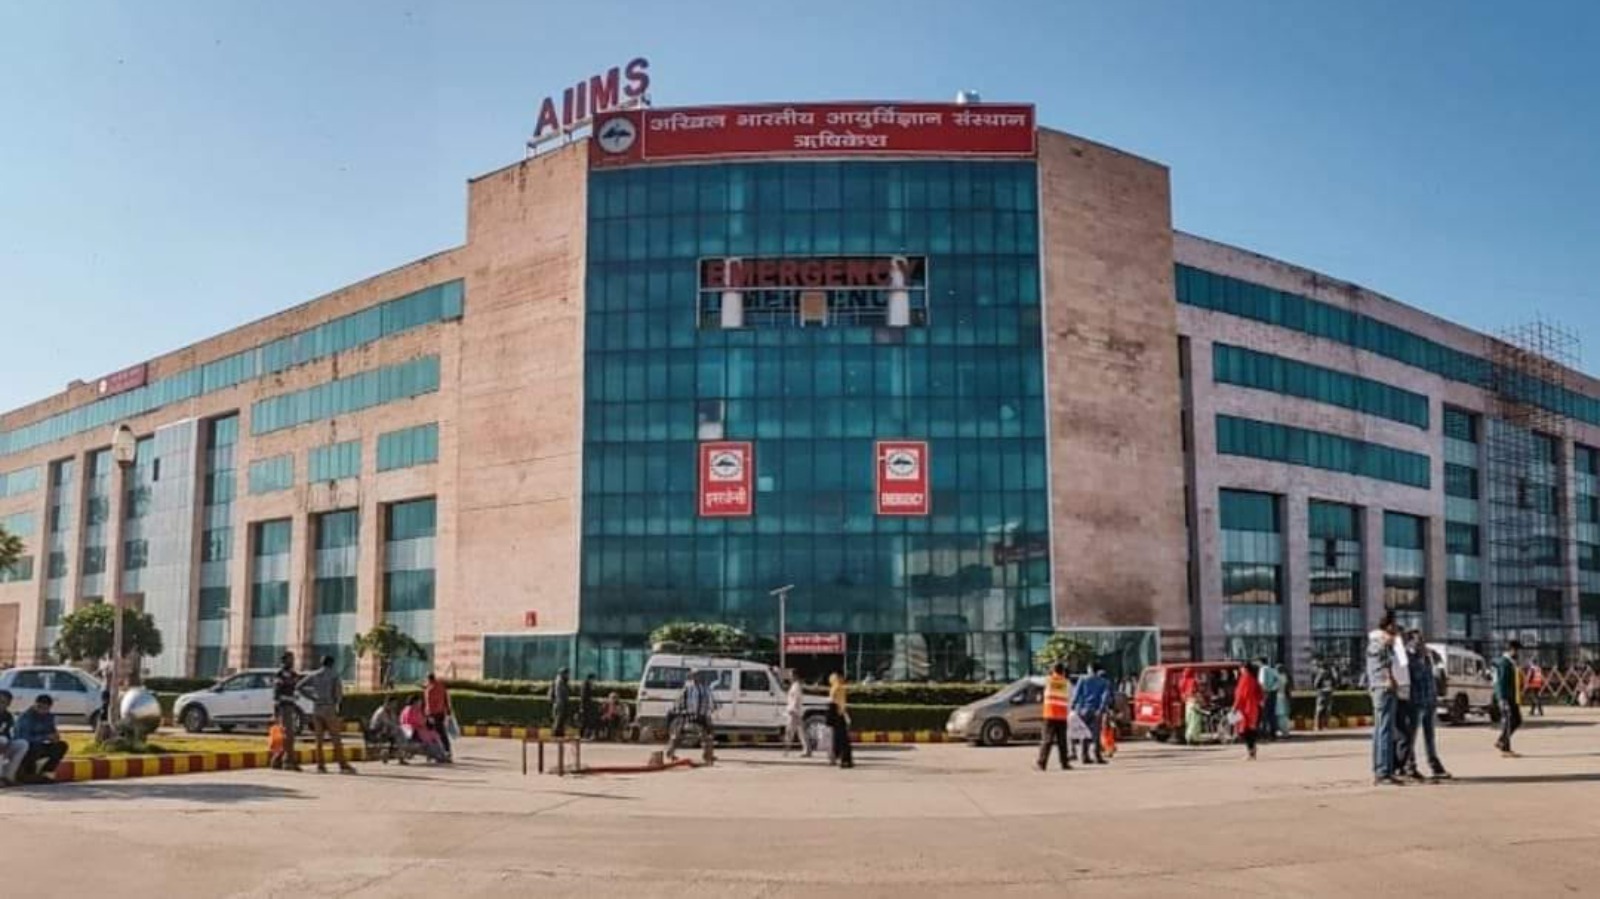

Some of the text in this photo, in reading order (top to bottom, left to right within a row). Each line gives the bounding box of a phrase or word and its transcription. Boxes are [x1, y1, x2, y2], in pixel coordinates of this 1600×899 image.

[533, 57, 649, 137] AIIMS
[651, 113, 726, 131] अखिल
[736, 108, 815, 127] भारतीय
[952, 110, 1026, 127] संस्थान
[793, 130, 888, 148] ऋषिकेश
